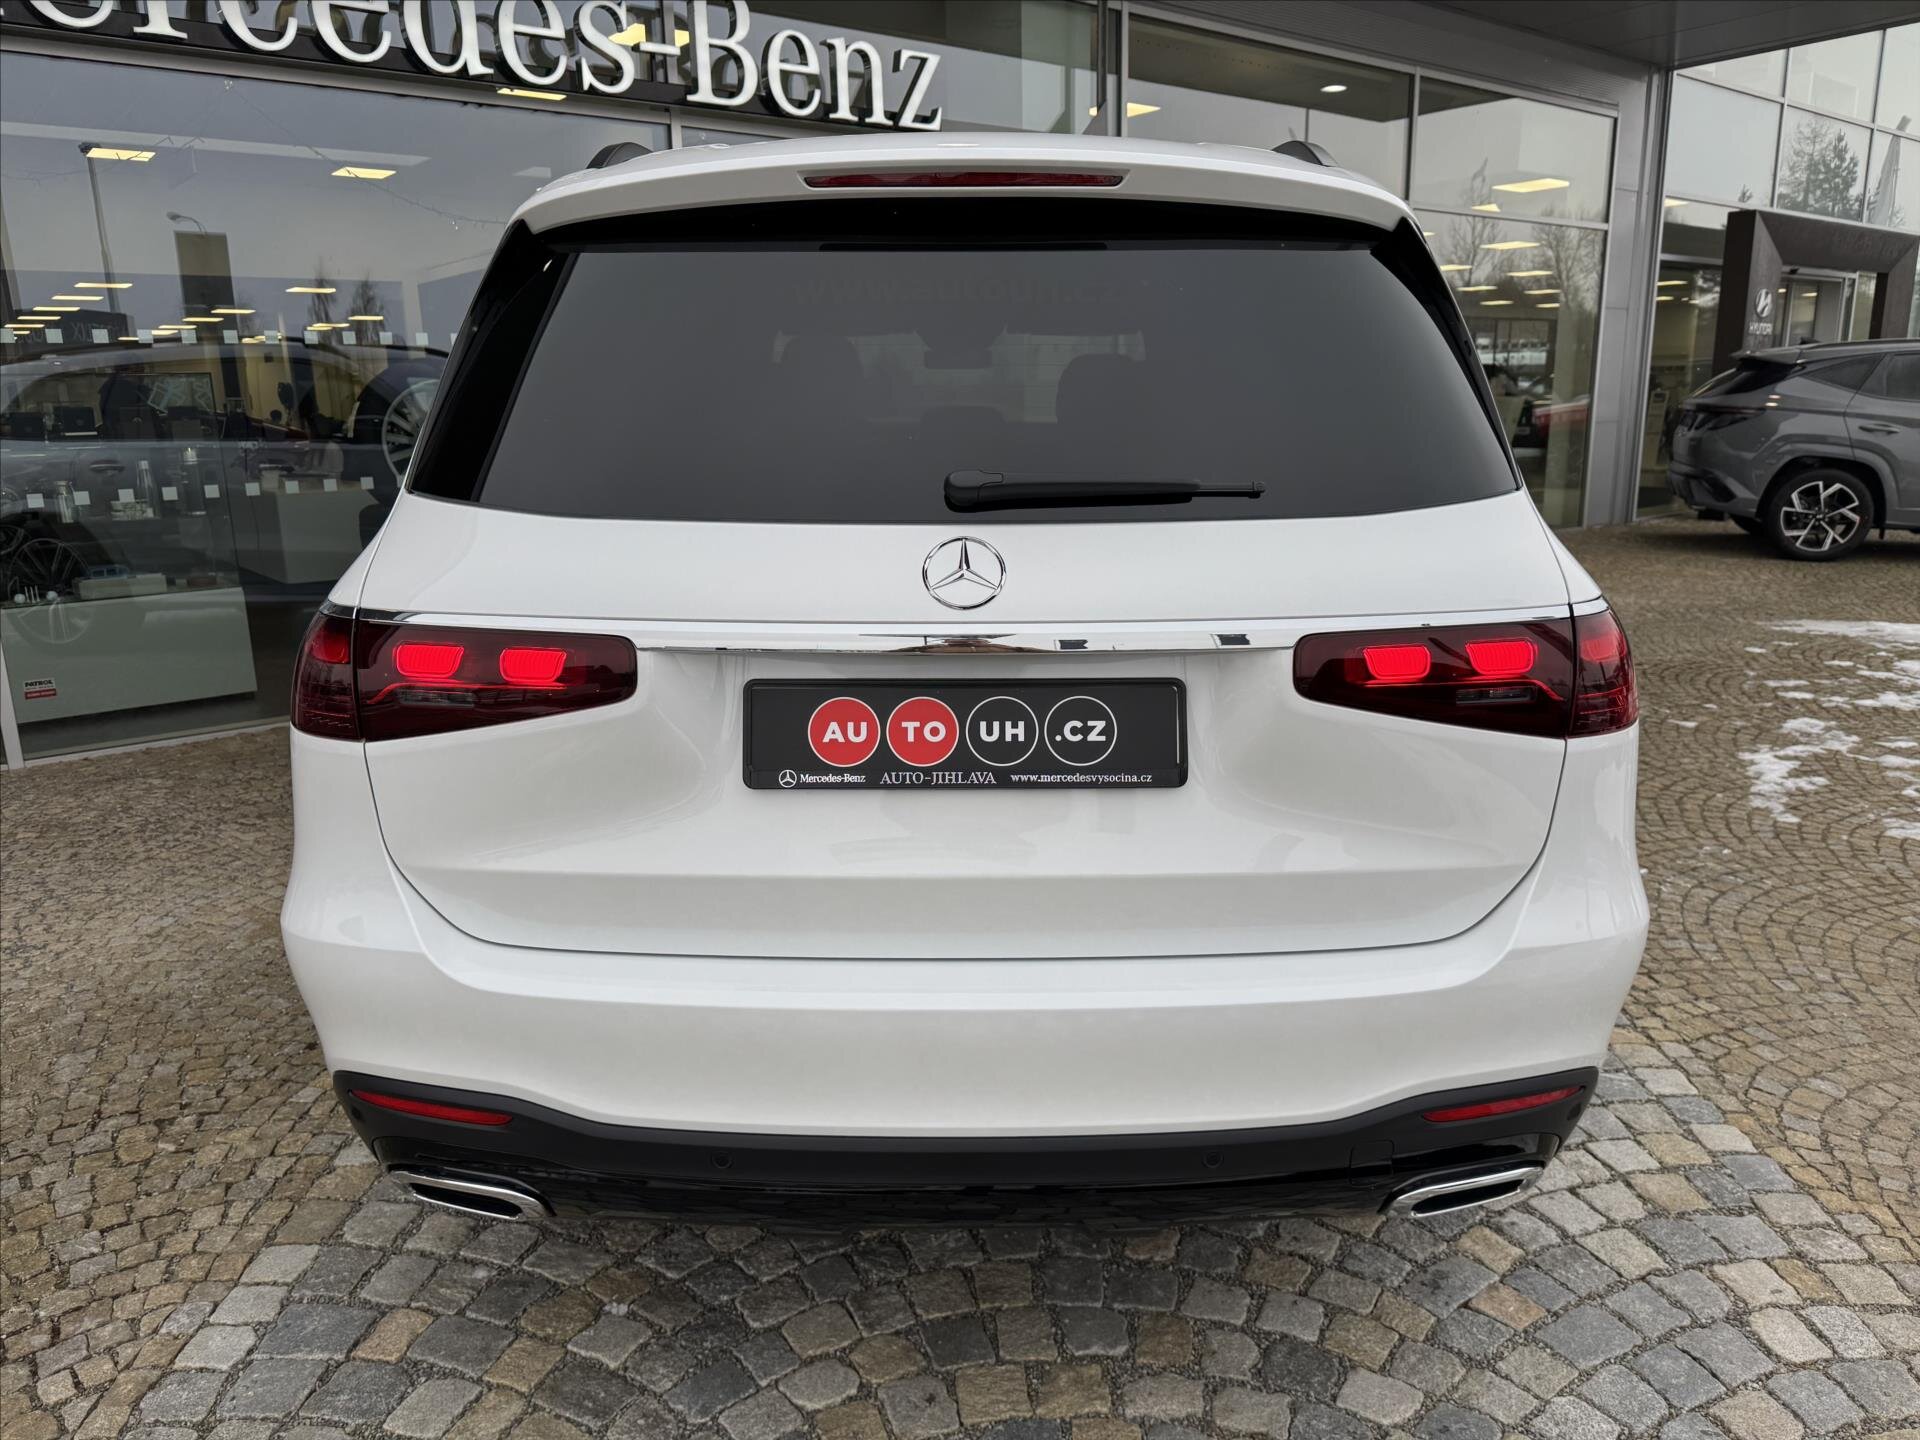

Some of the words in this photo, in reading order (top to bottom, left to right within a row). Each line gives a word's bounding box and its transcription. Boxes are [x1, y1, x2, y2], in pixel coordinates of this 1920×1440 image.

[822, 721, 868, 743] AU
[901, 721, 947, 743] TO
[979, 721, 1025, 742] UH
[1054, 720, 1107, 742] .CZ
[799, 773, 867, 784] Mercedes-Benz
[879, 771, 997, 785] AUTO-JIHLAVA
[1010, 772, 1153, 785] www.mercedesvysocina.cz
